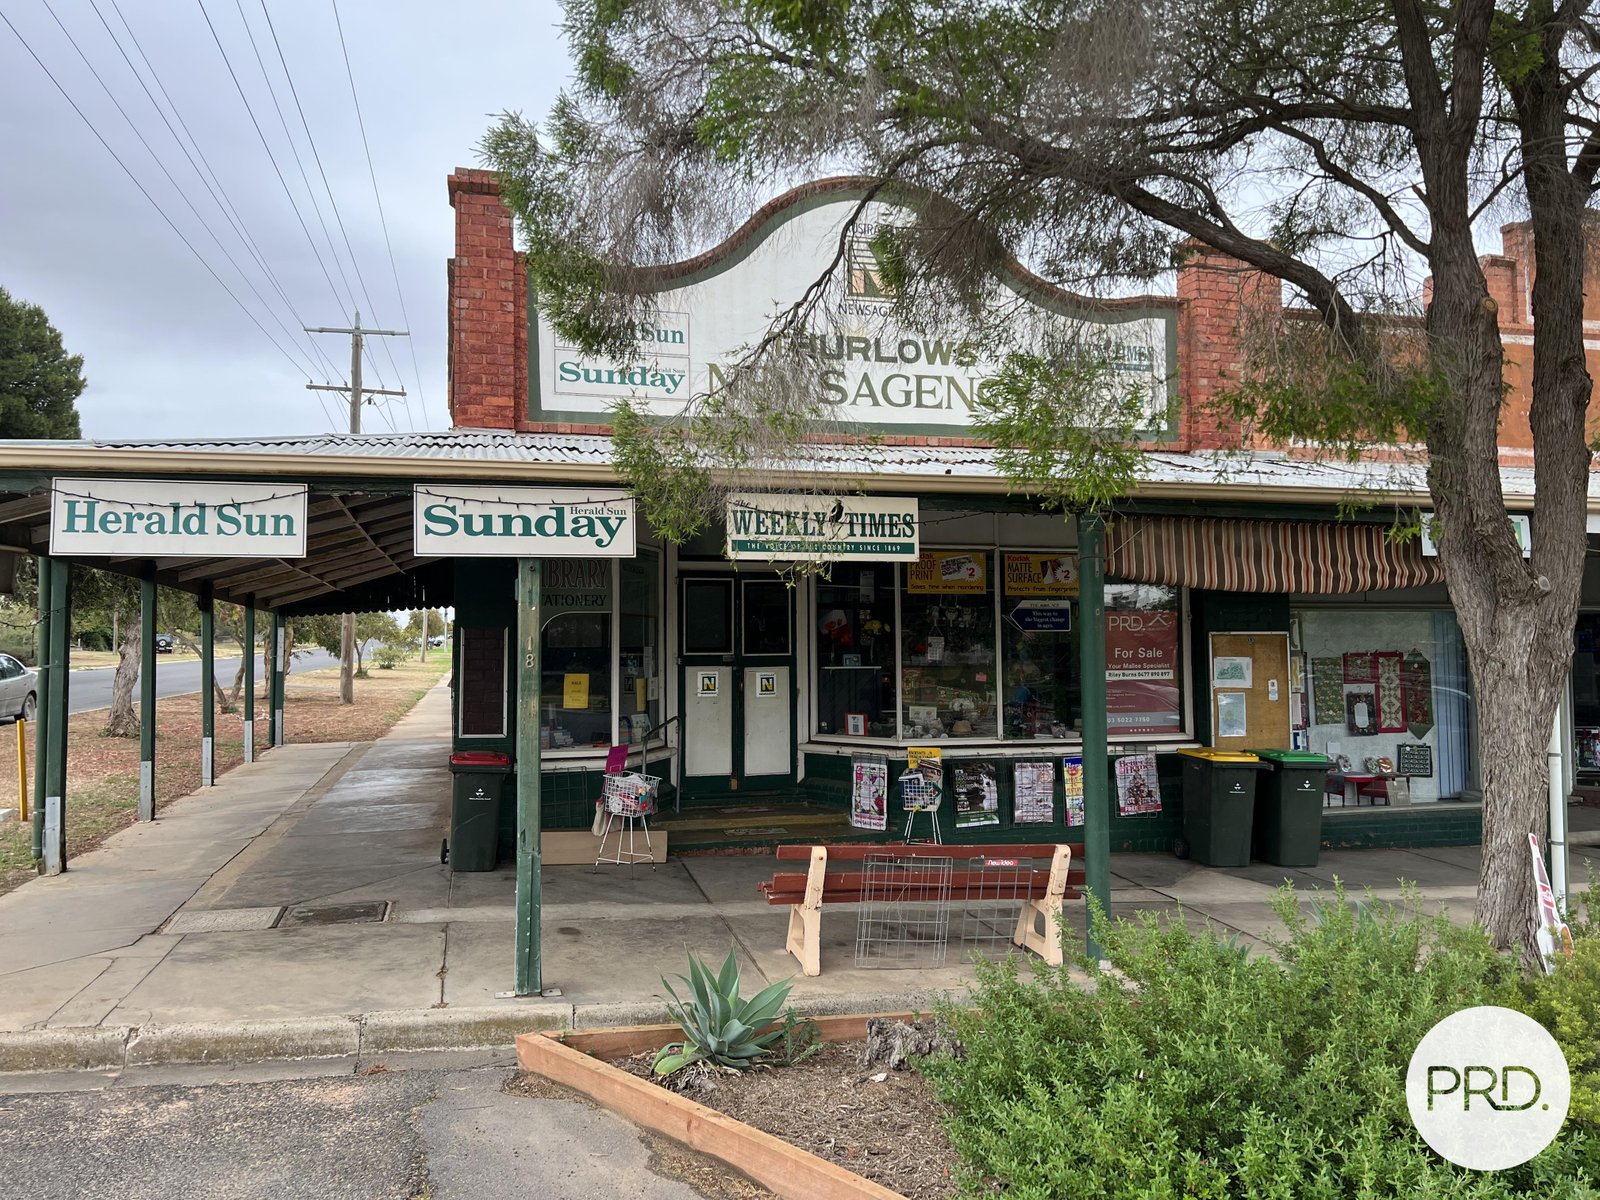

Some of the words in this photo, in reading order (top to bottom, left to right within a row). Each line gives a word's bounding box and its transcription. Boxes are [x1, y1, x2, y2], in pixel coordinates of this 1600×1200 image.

[559, 361, 686, 395] Sunday
[570, 506, 604, 516] Herald
[606, 507, 627, 516] Sun
[62, 500, 208, 536] Herald
[216, 503, 297, 537] Sun
[731, 509, 827, 537] WEEKLY
[845, 512, 916, 539] TIMES
[423, 504, 627, 548] Sunday
[747, 542, 760, 550] THE
[859, 544, 880, 552] SINCE
[919, 552, 936, 560] dak
[910, 560, 938, 570] PROOF
[1007, 562, 1033, 573] MATTE
[910, 570, 935, 581] PRINT
[1007, 573, 1042, 584] SURFACE
[1114, 647, 1134, 658] For
[1138, 647, 1163, 658] Sale
[703, 677, 716, 690] N
[761, 678, 774, 691] N
